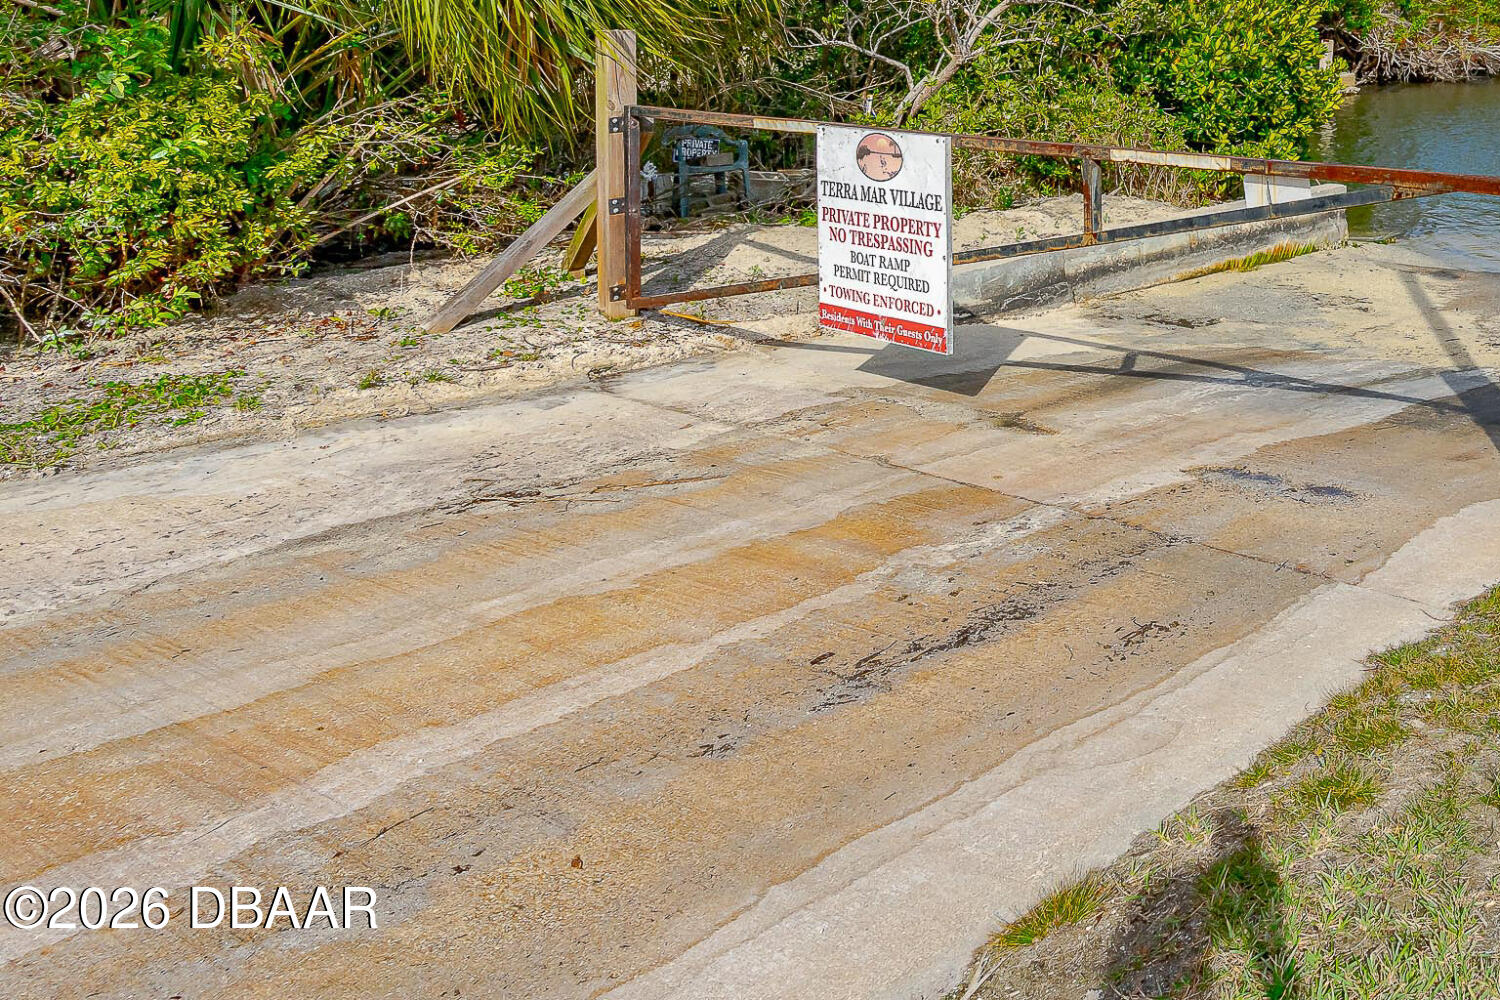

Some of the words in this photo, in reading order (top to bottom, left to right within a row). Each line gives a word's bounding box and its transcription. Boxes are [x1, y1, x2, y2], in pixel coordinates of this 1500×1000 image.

[681, 138, 714, 150] PRIVATE
[821, 180, 858, 200] TERRA
[861, 185, 888, 204] MAR
[890, 189, 943, 211] VILLAGE
[822, 206, 870, 228] PRIVATE
[873, 214, 942, 238] PROPERTY
[829, 226, 847, 243] NO
[849, 229, 934, 257] TRESPASSING
[850, 250, 876, 267] BOAT
[879, 255, 911, 272] RAMP
[834, 264, 870, 283] PERMIT
[873, 271, 930, 293] REQUIRED
[829, 285, 870, 305] TOWING
[873, 293, 935, 317] ENFORCED
[821, 308, 855, 325] Residents
[856, 316, 873, 330] With
[873, 320, 896, 334] Their
[896, 325, 923, 340] Guests
[923, 331, 943, 346] Only
